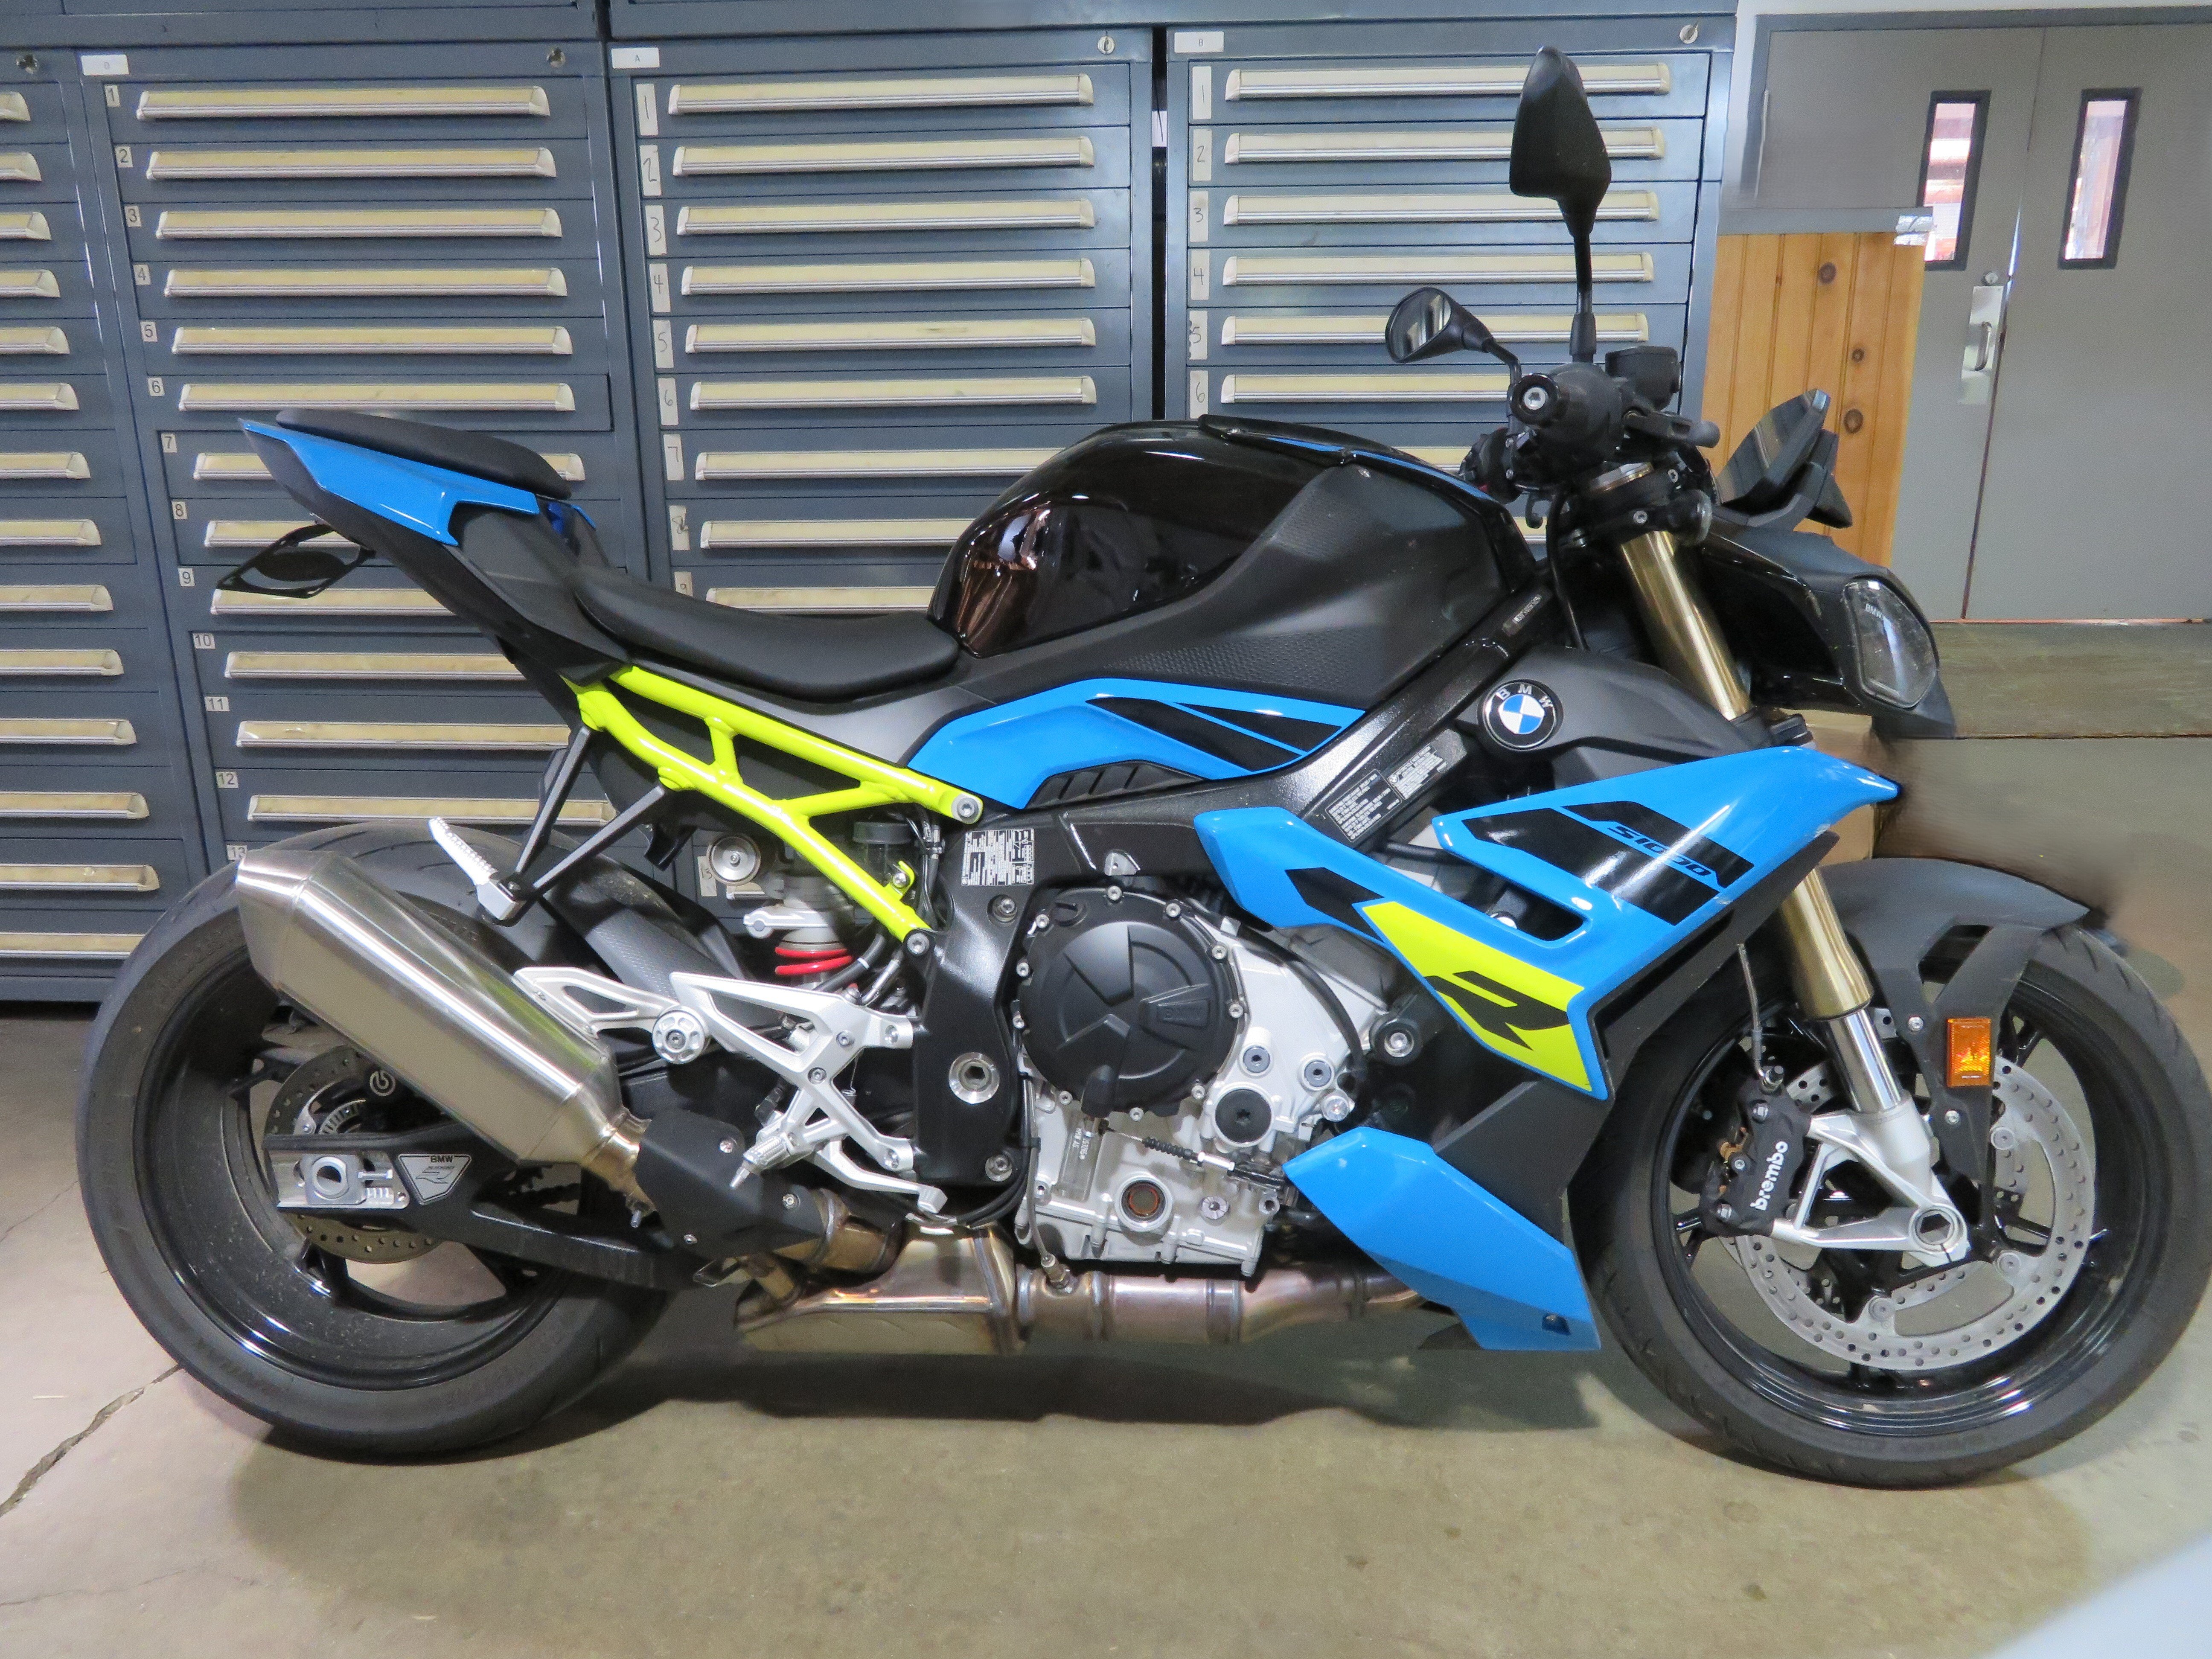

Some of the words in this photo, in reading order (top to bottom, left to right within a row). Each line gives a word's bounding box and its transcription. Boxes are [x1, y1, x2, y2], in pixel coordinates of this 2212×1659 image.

[108, 87, 115, 102] 1
[1201, 84, 1205, 104] 1
[644, 95, 649, 120] 1
[118, 149, 129, 163] 2
[1196, 145, 1205, 163] 2
[643, 157, 657, 182] 2
[128, 207, 137, 223] 3
[1193, 207, 1203, 223] 3
[651, 217, 662, 243] 3
[138, 267, 147, 281] 4
[1193, 268, 1205, 285] 4
[653, 274, 664, 294] 4
[145, 324, 153, 338] 5
[1190, 326, 1202, 344] 5
[658, 332, 668, 352] 5
[151, 380, 161, 393] 6
[1196, 381, 1205, 404] 6
[664, 389, 673, 407] 6
[164, 436, 172, 449] 7
[667, 446, 679, 462] 7
[175, 504, 184, 517] 8
[182, 571, 191, 584] 9
[1865, 603, 1883, 618] BMW
[195, 634, 212, 647] 10
[209, 698, 224, 710] 11
[1495, 684, 1554, 708] BMW
[219, 772, 236, 785] 12
[1750, 1141, 1789, 1211] brembo
